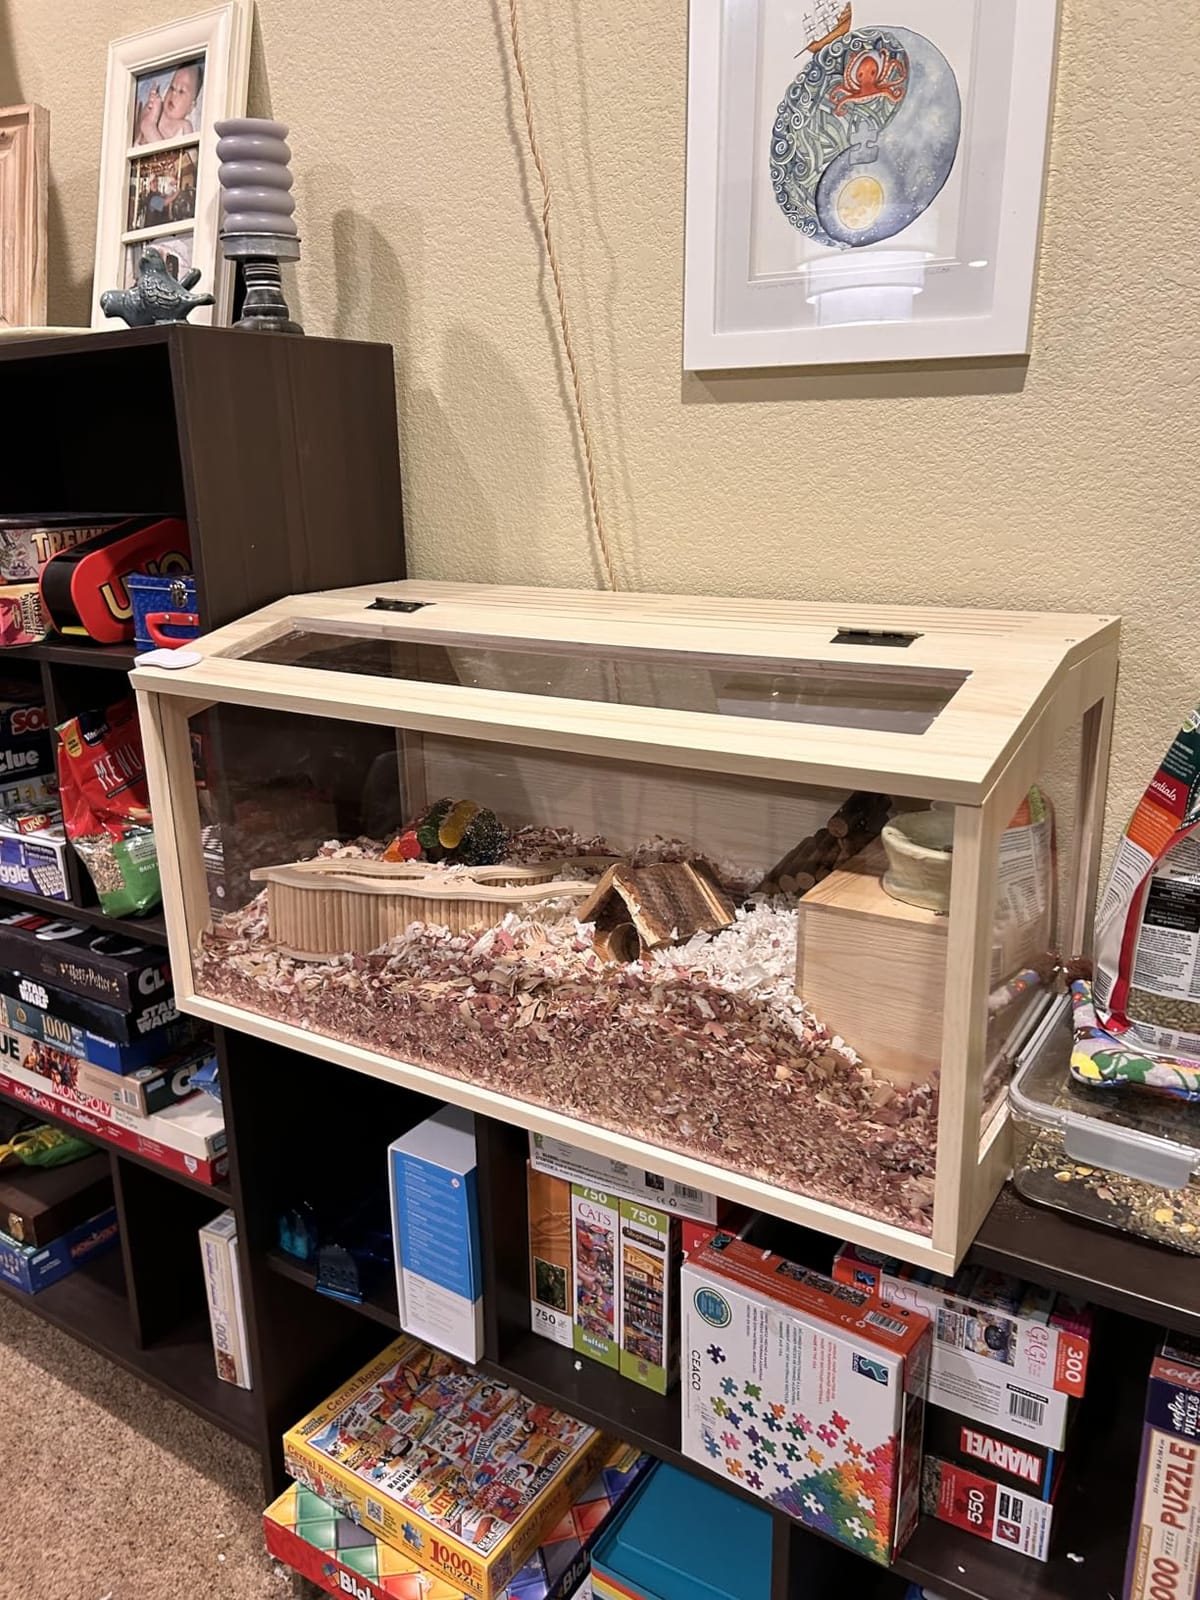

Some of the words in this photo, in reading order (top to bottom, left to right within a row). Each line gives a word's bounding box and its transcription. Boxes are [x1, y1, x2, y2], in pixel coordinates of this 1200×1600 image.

[30, 591, 45, 636] HISTORY
[93, 743, 142, 791] MENU
[24, 815, 47, 832] UNO
[19, 984, 49, 1010] WARS
[21, 979, 46, 998] STAR
[40, 1014, 71, 1045] 1000
[53, 1083, 111, 1116] MONOPOLY
[583, 1188, 607, 1204] 750
[578, 1202, 611, 1226] CATS
[630, 1207, 657, 1226] 750
[535, 1307, 556, 1325] 750
[216, 1324, 228, 1350] 500
[582, 1334, 609, 1352] Buffalo
[691, 1349, 701, 1391] CEACO
[1065, 1347, 1083, 1384] 300
[327, 1384, 357, 1412] Cereal
[358, 1361, 386, 1385] Boxes
[1184, 1404, 1198, 1436] PIECE
[287, 1444, 317, 1472] Cereal
[474, 1437, 492, 1466] WHEATIES
[962, 1428, 1041, 1484] MARVEL
[387, 1469, 411, 1489] RAISIN
[396, 1474, 418, 1493] BRAN
[520, 1486, 537, 1505] 1000
[534, 1468, 552, 1490] PIECE
[547, 1448, 569, 1474] PUZZLE
[1160, 1442, 1198, 1530] PUZZLE
[430, 1490, 457, 1515] JETS
[967, 1489, 985, 1526] 550
[429, 1537, 473, 1578] 1000
[1164, 1531, 1175, 1556] PIECE
[442, 1562, 484, 1592] PUZZLE
